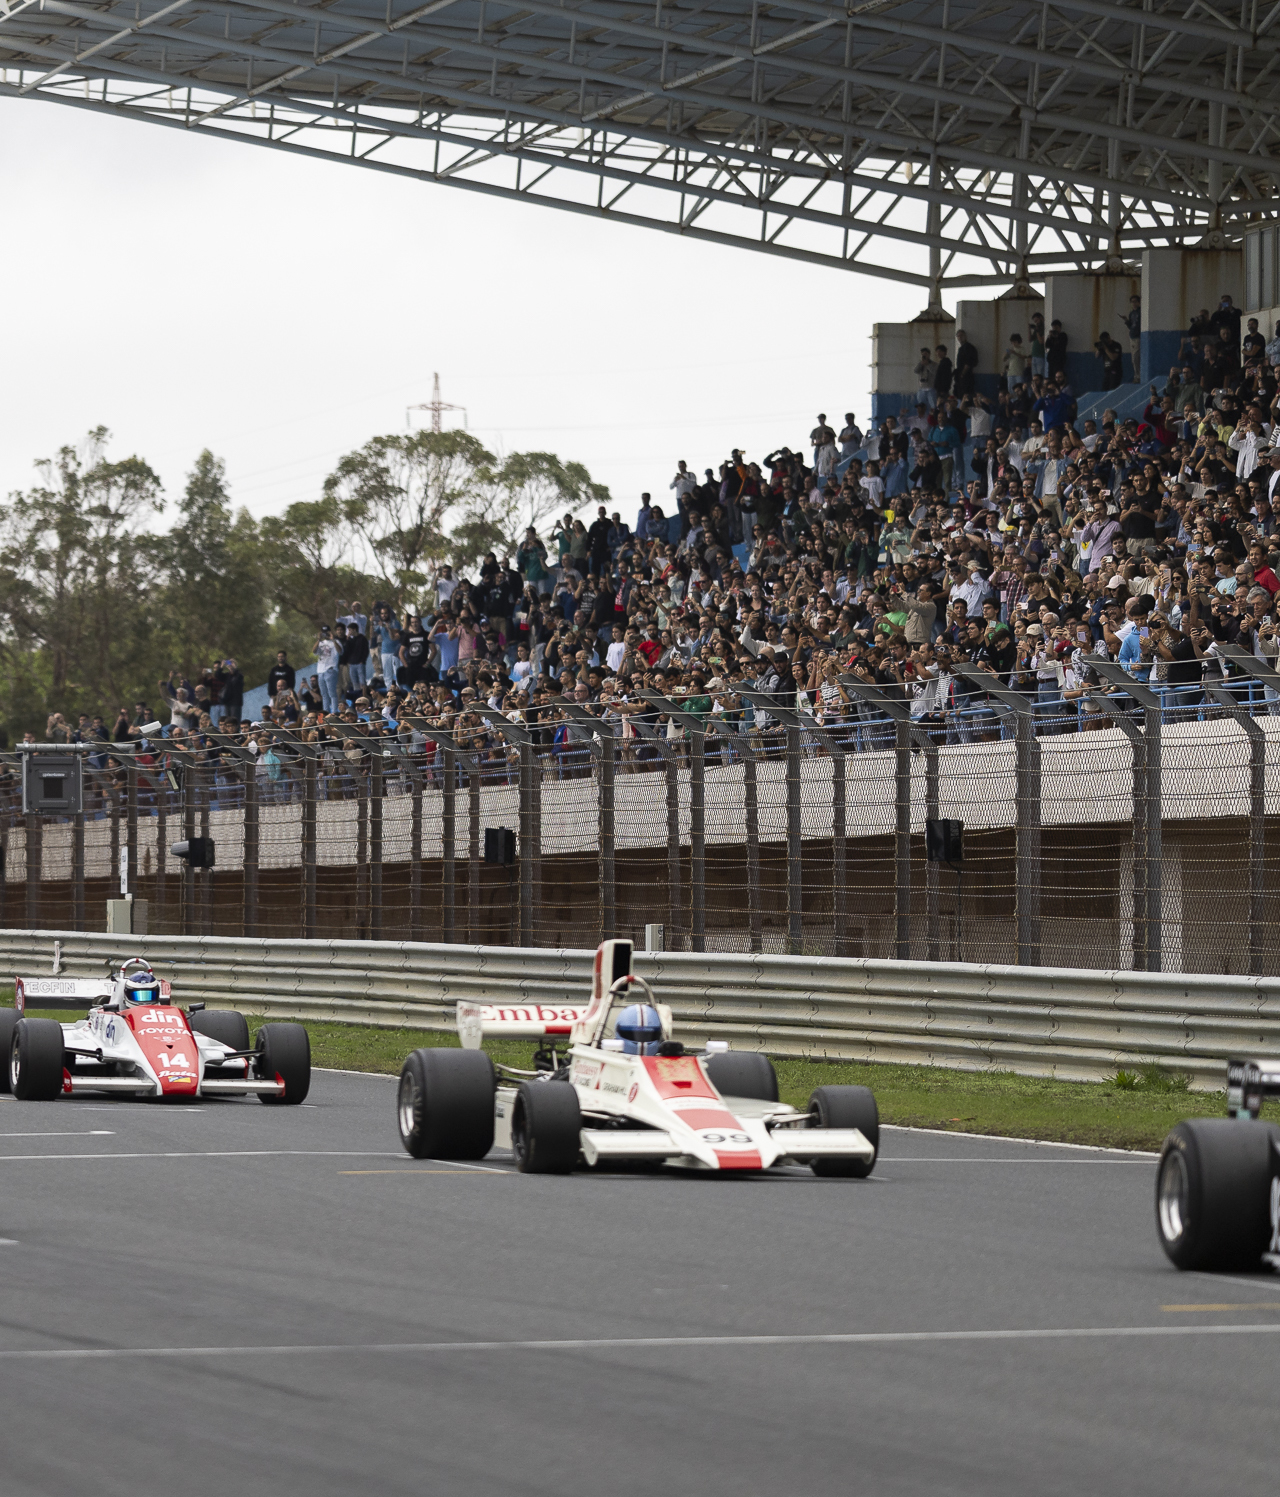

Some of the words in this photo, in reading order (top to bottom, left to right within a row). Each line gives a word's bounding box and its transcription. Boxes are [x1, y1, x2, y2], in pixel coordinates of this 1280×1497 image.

[24, 981, 76, 994] TECFIN
[141, 1009, 184, 1028] din
[480, 1004, 587, 1021] Emba
[138, 1027, 192, 1036] TOYOTA
[157, 1052, 190, 1068] 14
[158, 1069, 198, 1078] Bata
[703, 1133, 753, 1144] 99
